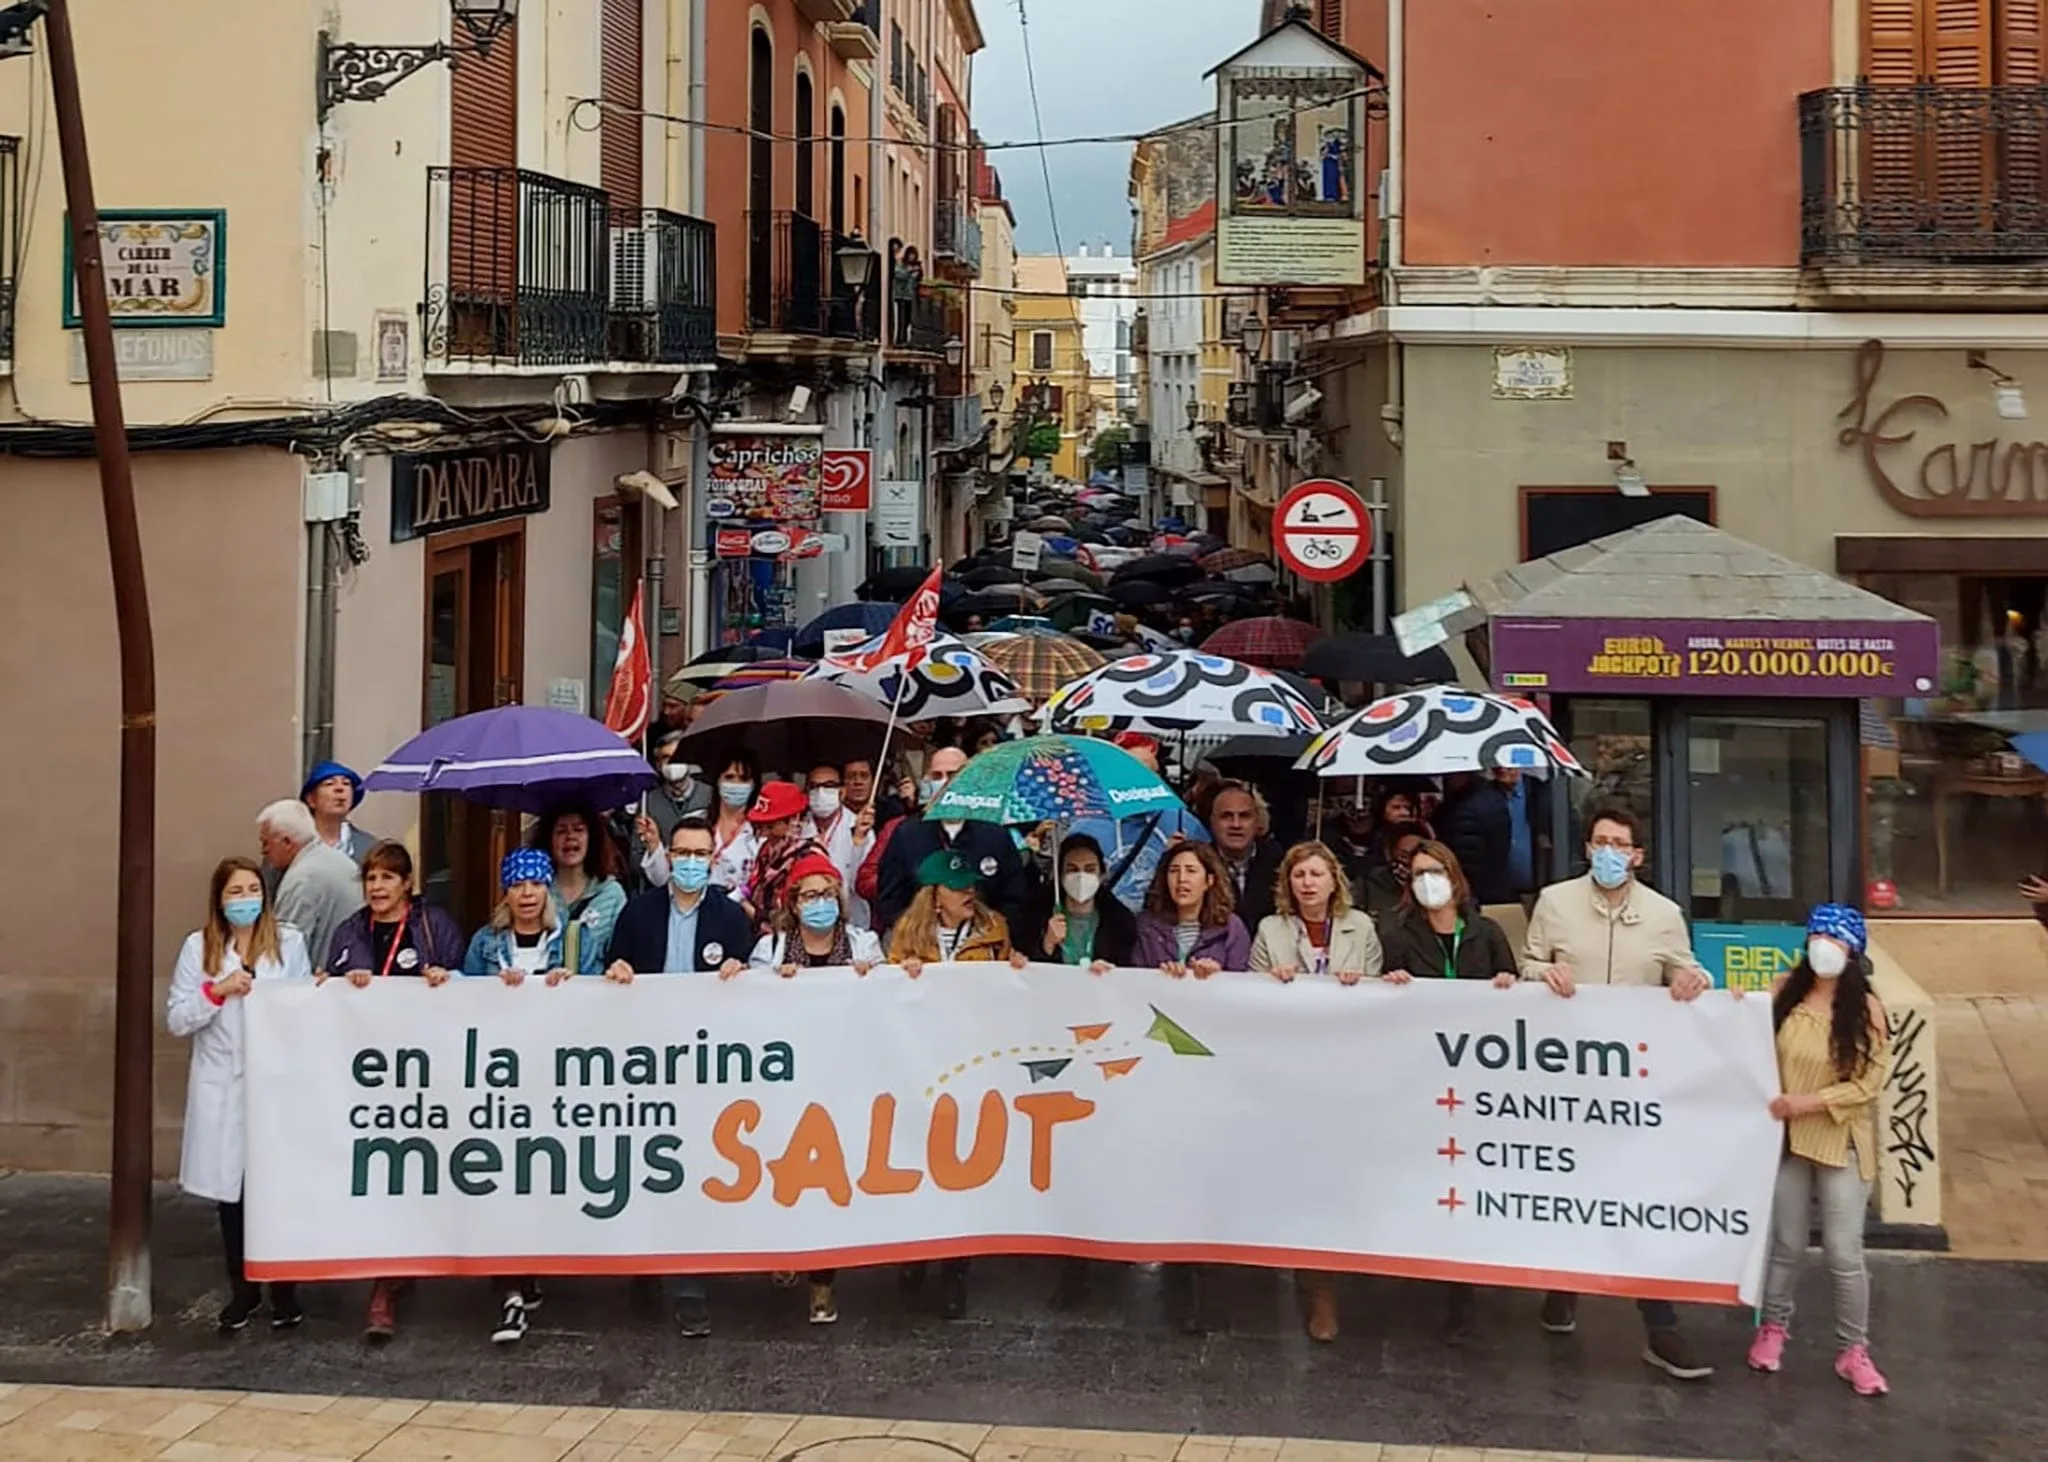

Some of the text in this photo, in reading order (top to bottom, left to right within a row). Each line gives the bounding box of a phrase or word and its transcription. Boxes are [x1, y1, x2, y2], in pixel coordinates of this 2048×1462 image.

[118, 247, 172, 261] CARRER
[109, 278, 181, 297] MAR
[708, 442, 822, 471] Caprichos
[412, 450, 541, 528] DANDARA
[1603, 637, 1660, 655] EURO
[1588, 655, 1676, 677] JACKPOT
[1688, 650, 1896, 677] 120.000.000€
[1108, 783, 1171, 804] Desigual
[1725, 944, 1802, 971] BIEN
[352, 1027, 795, 1089] en la marina
[1434, 1018, 1650, 1079] volem:
[350, 1092, 678, 1130] cada dia tenim
[1475, 1091, 1663, 1128] SANITARIS
[351, 1088, 1096, 1220] menys SALUT
[1475, 1141, 1577, 1173] CITES
[1475, 1189, 1750, 1237] INTERVENCIONS
